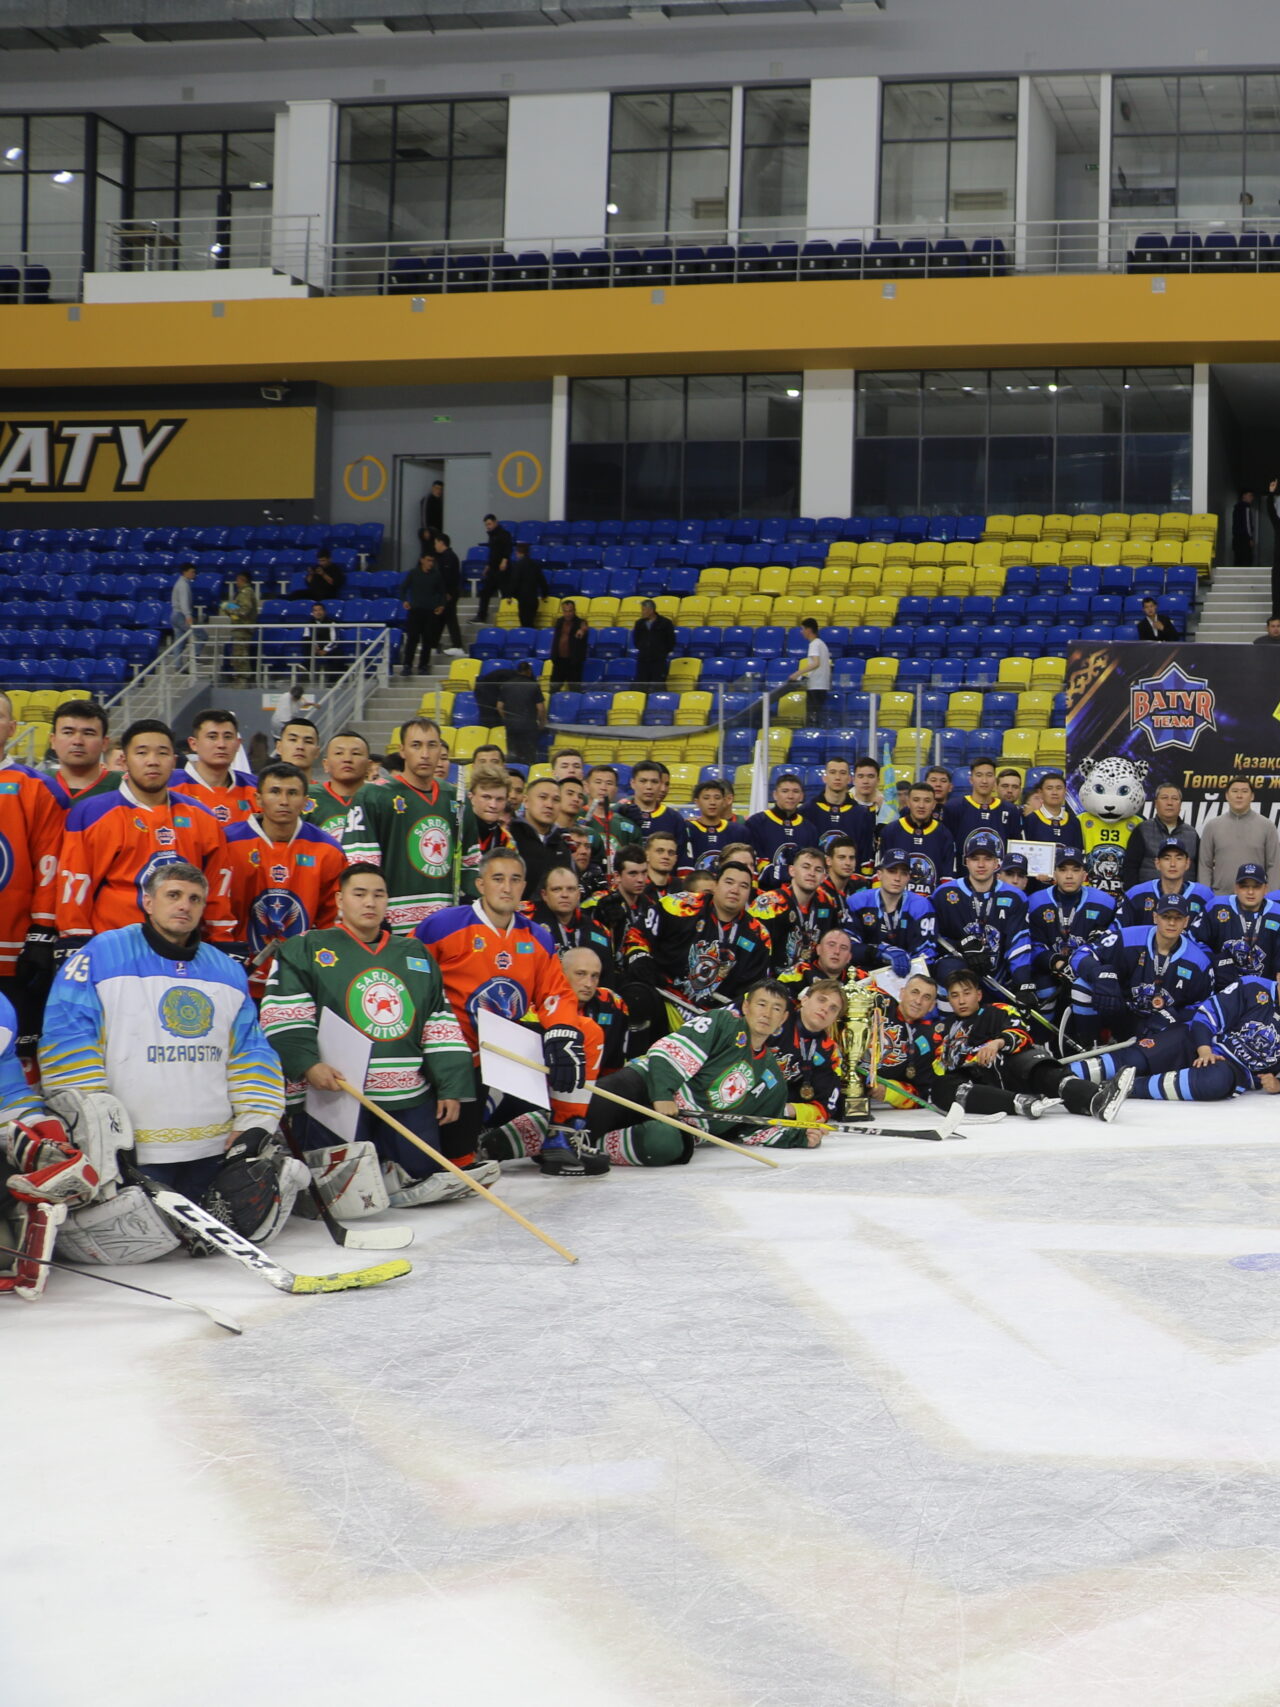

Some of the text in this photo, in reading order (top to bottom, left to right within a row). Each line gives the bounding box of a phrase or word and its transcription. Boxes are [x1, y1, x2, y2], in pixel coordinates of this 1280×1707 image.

[1134, 691, 1212, 723] BATYR
[1152, 716, 1194, 728] TEAM
[1100, 830, 1120, 841] 93
[61, 871, 90, 905] 77
[906, 884, 931, 893] РДА
[355, 971, 404, 992] SARDAR
[363, 1024, 407, 1041] AQTOBE
[147, 1045, 223, 1063] QAZAQSTAN
